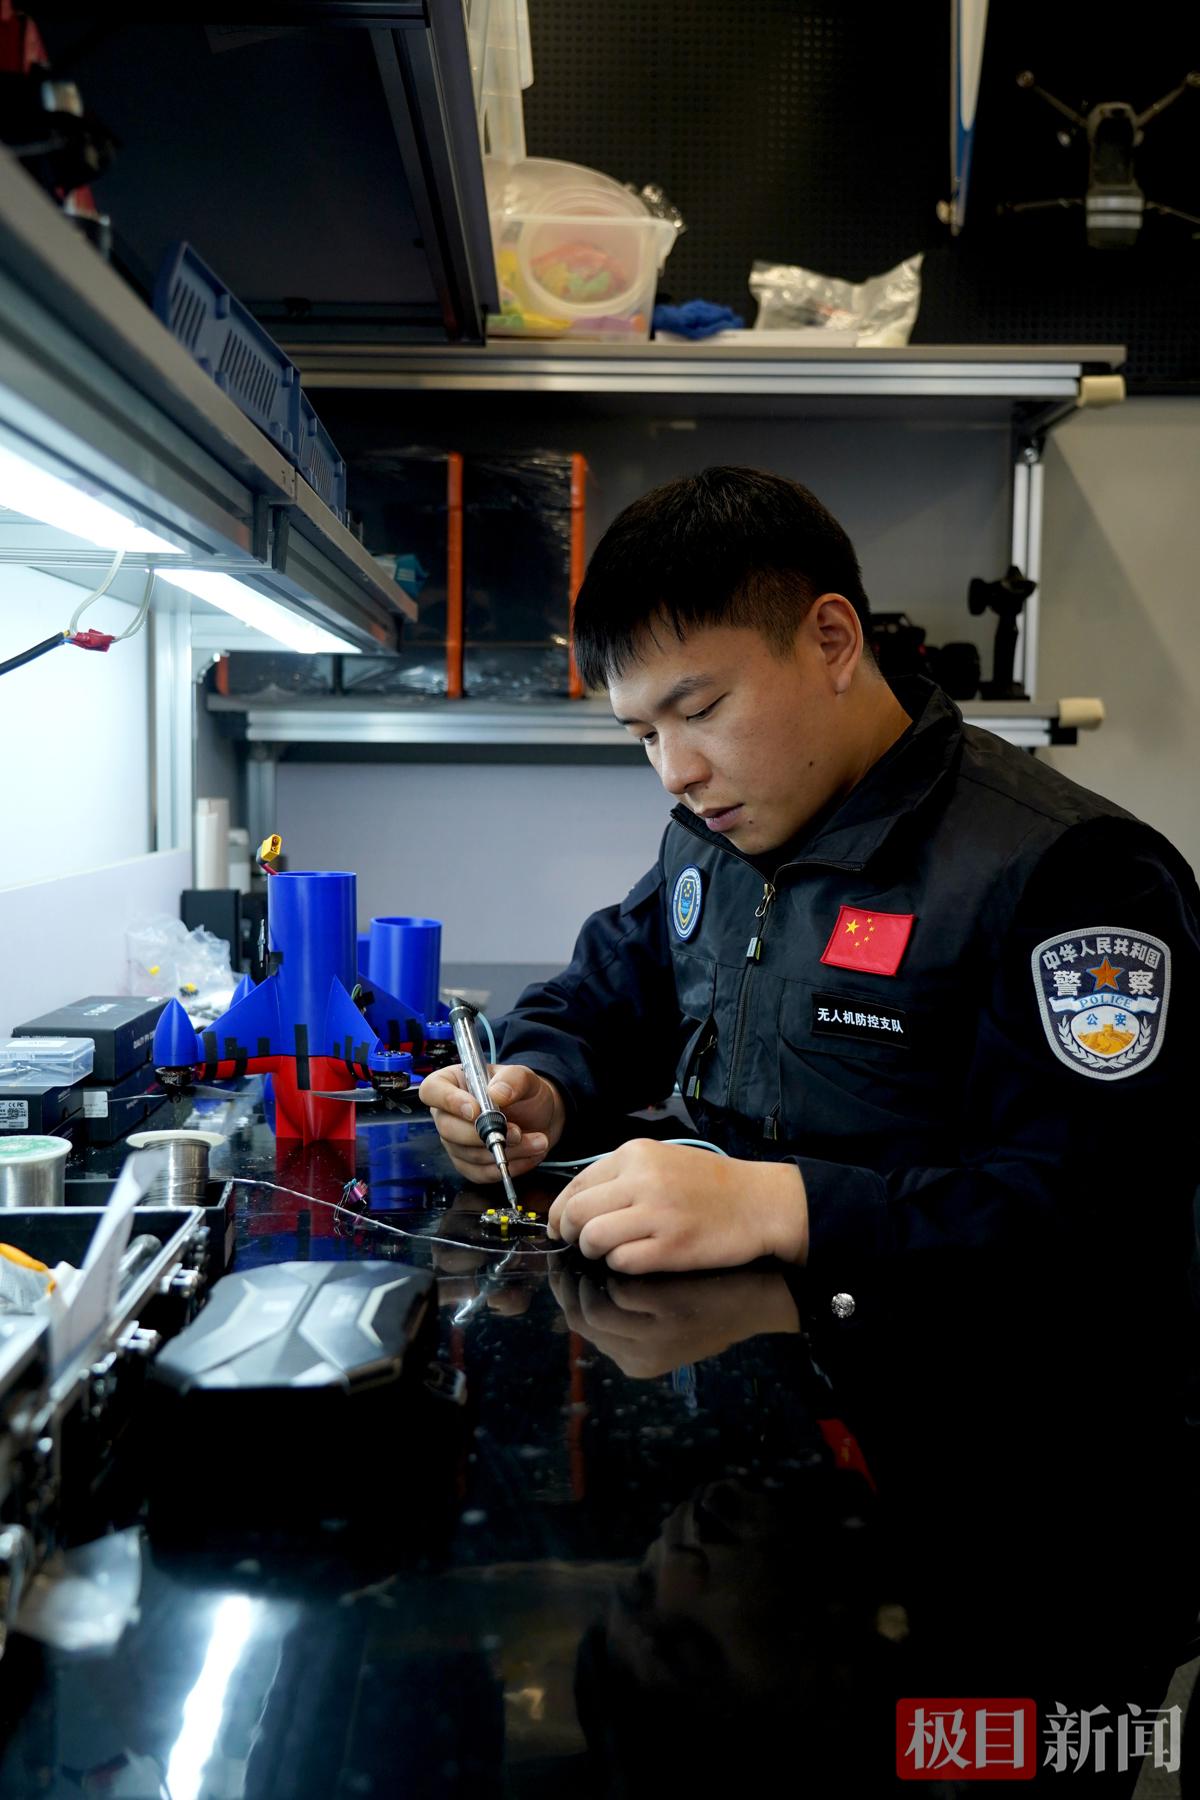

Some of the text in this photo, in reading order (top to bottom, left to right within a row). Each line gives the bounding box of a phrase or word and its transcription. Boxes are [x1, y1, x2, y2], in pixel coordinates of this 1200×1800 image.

[1042, 937, 1161, 970] 中华人民共和国
[1080, 994, 1132, 1009] POLICE
[817, 1007, 904, 1033] 无人机防控支队
